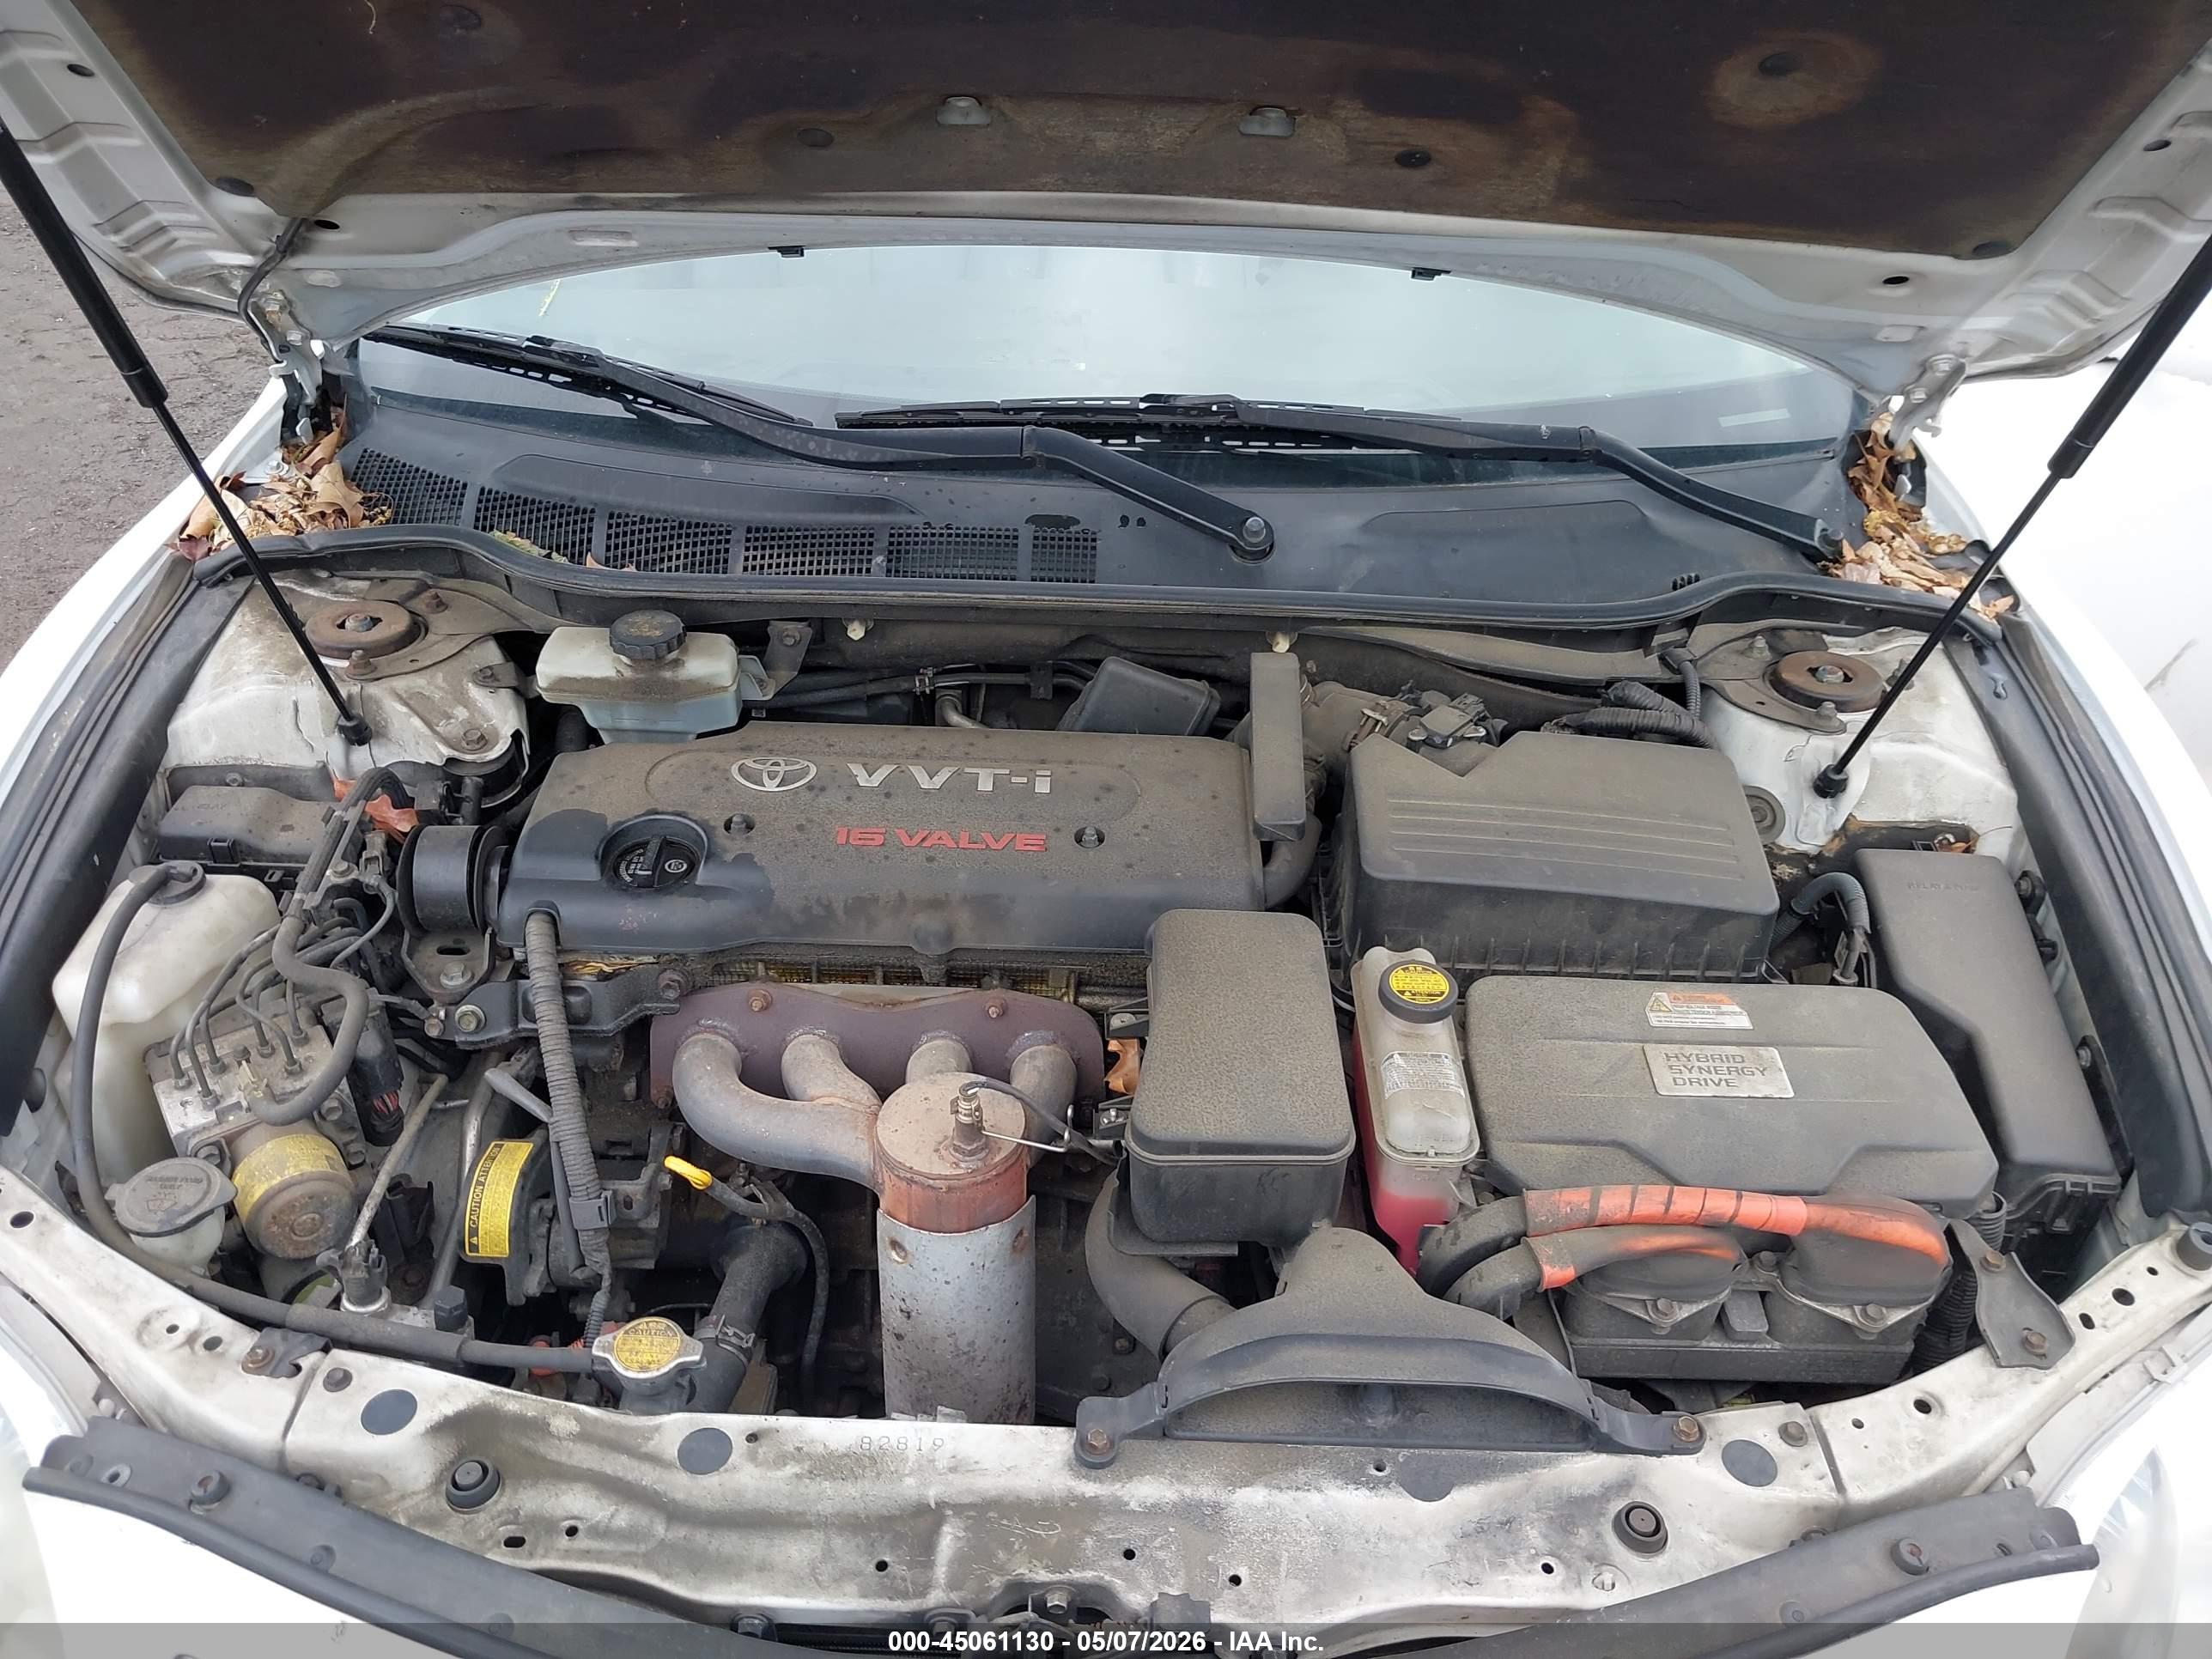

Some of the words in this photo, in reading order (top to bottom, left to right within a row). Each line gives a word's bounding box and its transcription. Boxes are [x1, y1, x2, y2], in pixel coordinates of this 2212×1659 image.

[847, 763, 1052, 793] VVT-i
[836, 826, 886, 846] 16
[896, 828, 1047, 851] VALVE
[1663, 1052, 1745, 1064] HYBRID
[1668, 1065, 1768, 1076] SYNERGY
[1674, 1077, 1738, 1087] DRIVE
[470, 1184, 483, 1228] CAUTION
[860, 1436, 945, 1451] 82819
